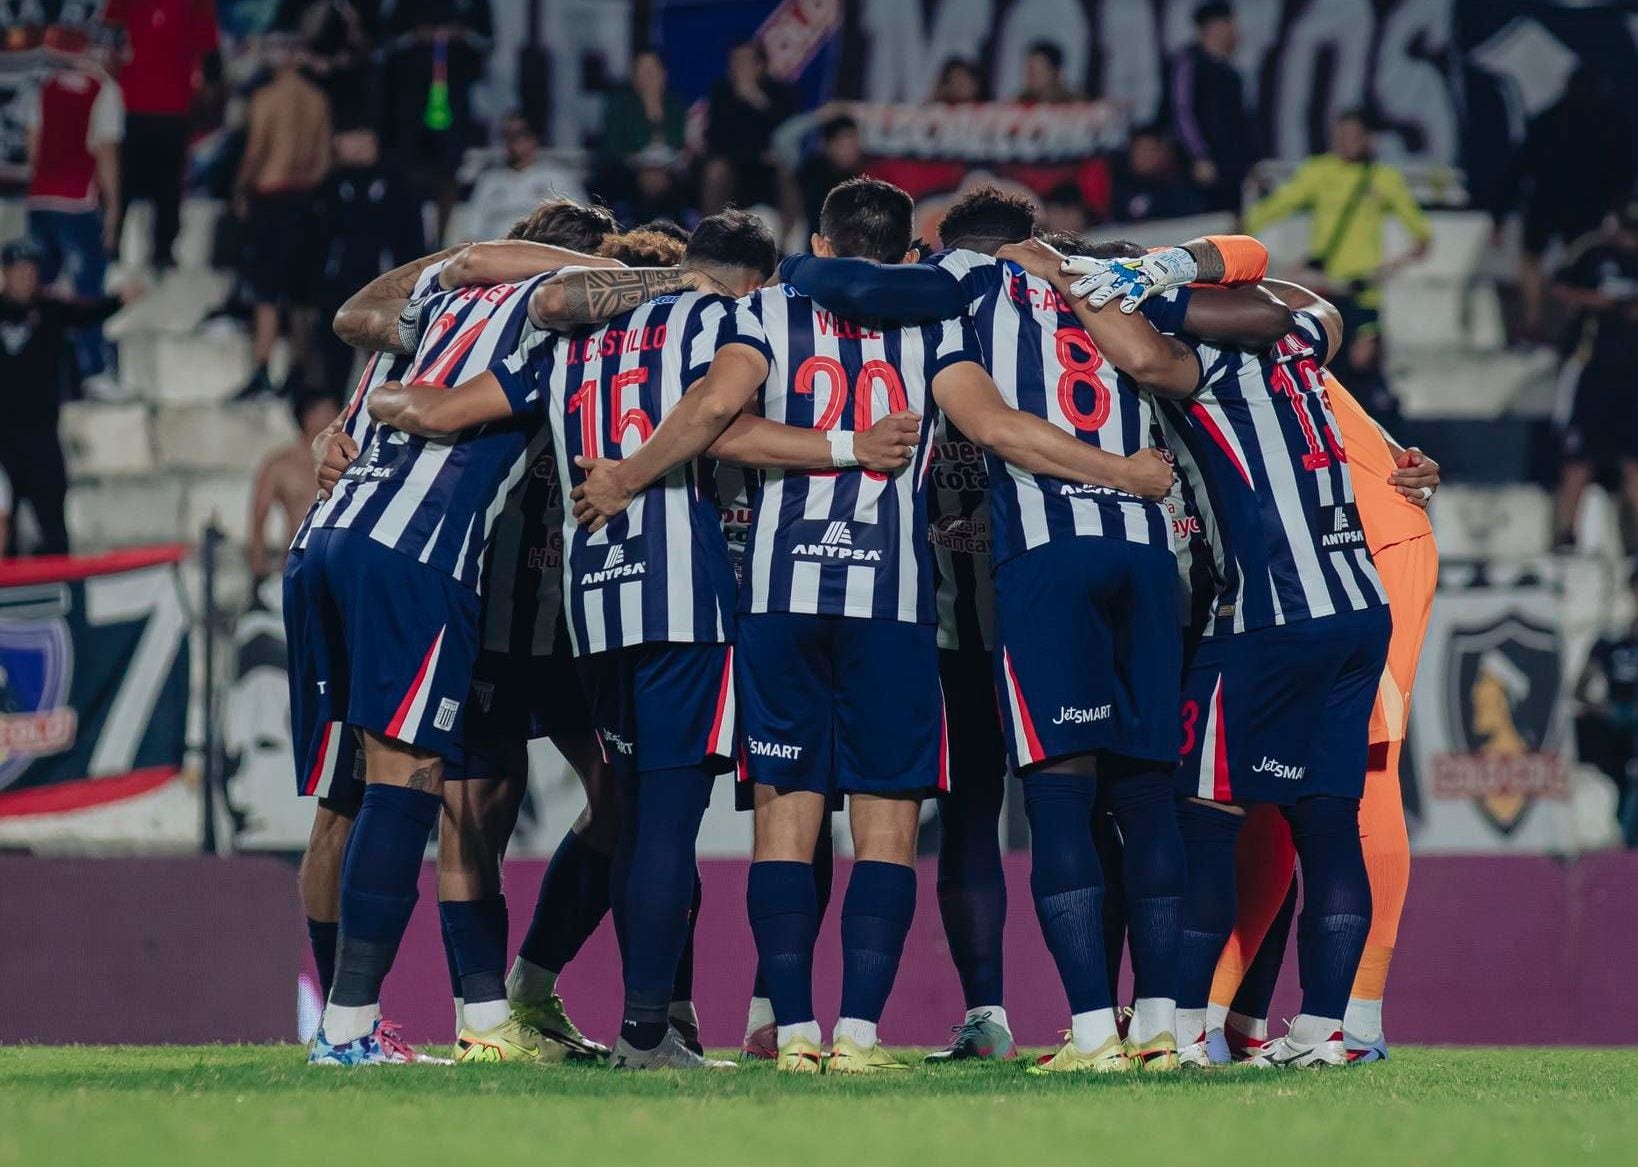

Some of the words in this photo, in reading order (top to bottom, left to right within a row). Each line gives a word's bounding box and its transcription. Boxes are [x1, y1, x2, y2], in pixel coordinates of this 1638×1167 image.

[1053, 326, 1111, 433] 8
[568, 366, 654, 462] 15
[795, 356, 909, 481] 20
[1322, 530, 1365, 547] ANYPSA
[791, 543, 882, 561] ANYPSA
[581, 561, 647, 586] ANYPSA
[1052, 703, 1112, 725] JetSMART
[1252, 755, 1307, 781] JetSMA
